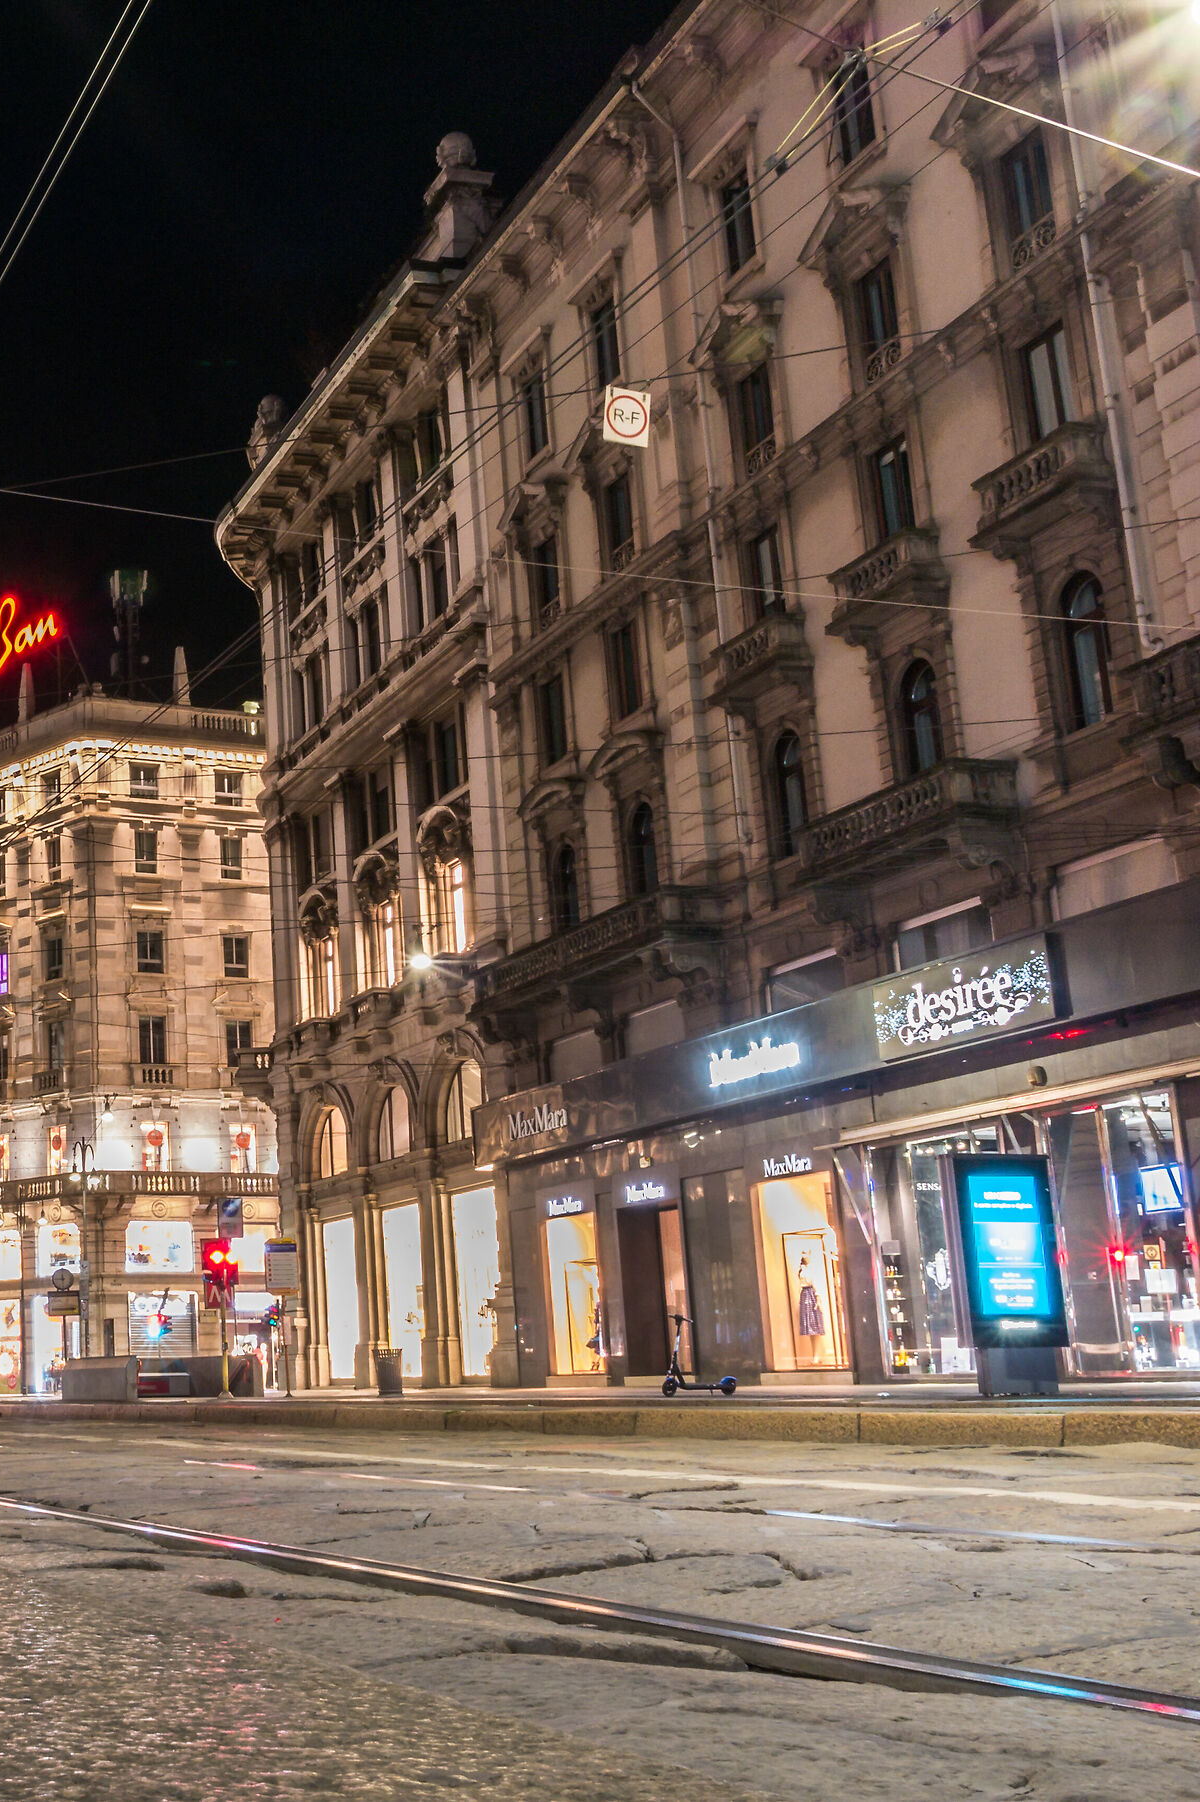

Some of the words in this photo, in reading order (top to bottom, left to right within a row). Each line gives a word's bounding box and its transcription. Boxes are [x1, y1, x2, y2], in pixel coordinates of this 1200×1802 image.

[614, 408, 641, 424] R-F
[507, 1103, 569, 1141] MaxMara
[763, 1153, 813, 1178] MaxMara
